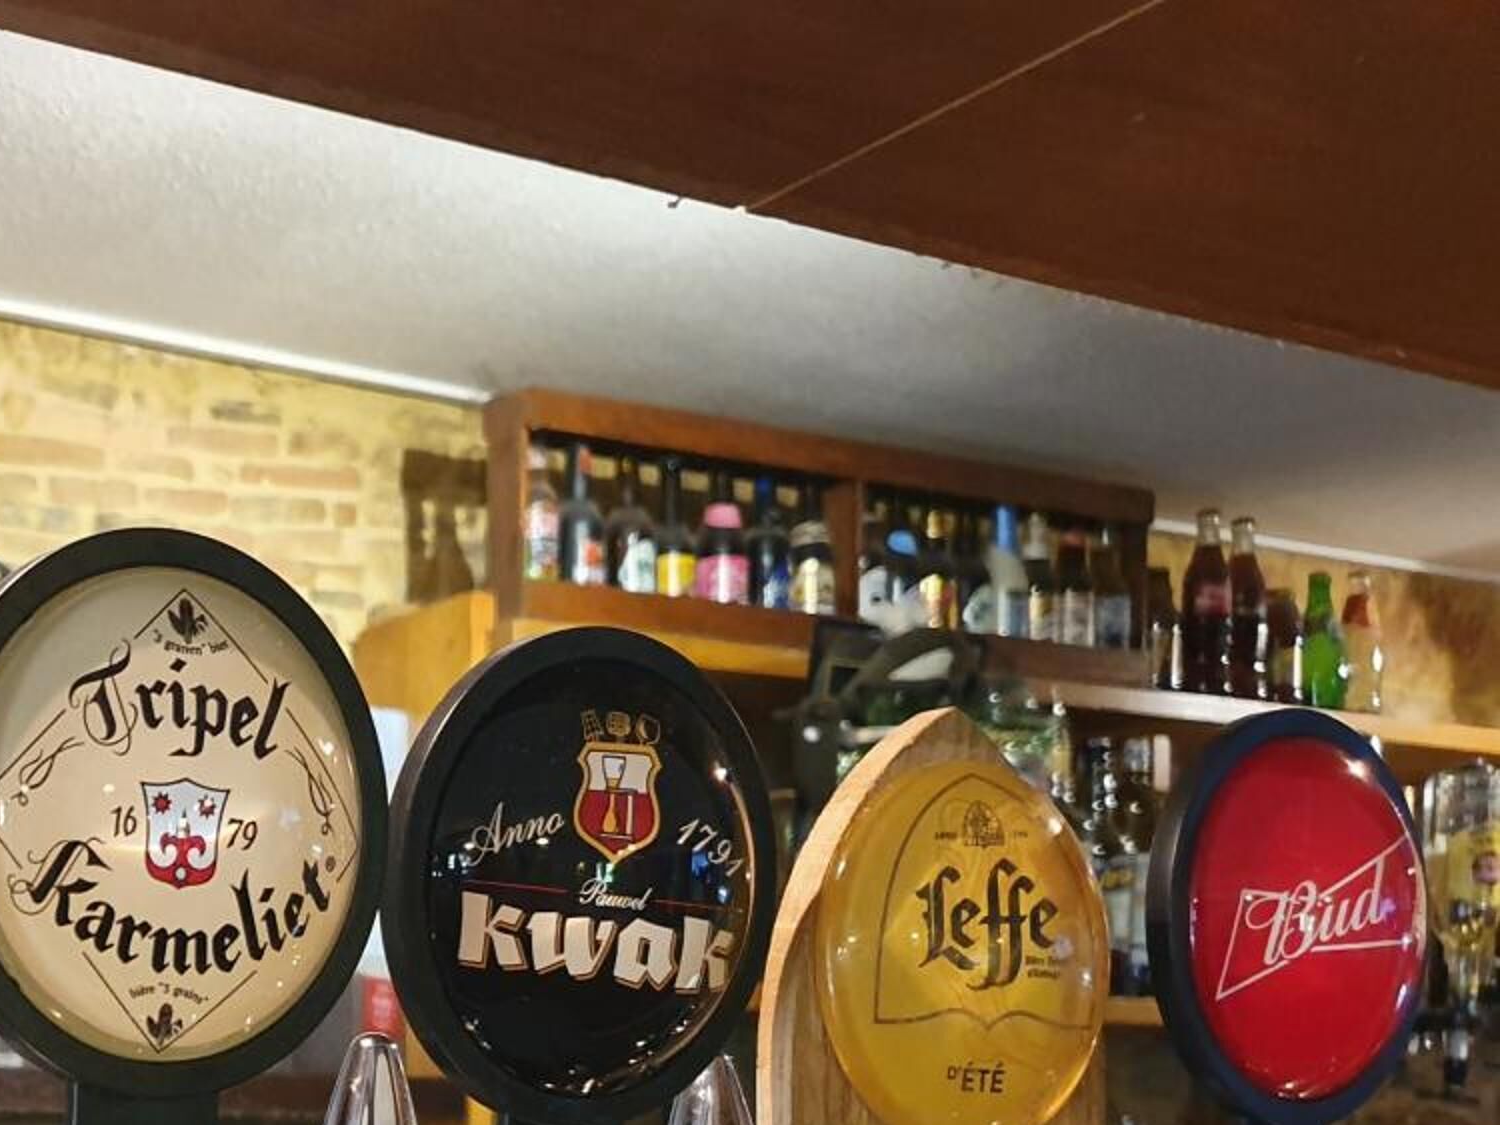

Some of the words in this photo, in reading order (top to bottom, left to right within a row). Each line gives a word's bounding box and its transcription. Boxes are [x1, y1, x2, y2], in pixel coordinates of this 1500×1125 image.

[68, 636, 291, 760] Tripel
[110, 806, 138, 838] 16
[227, 816, 259, 851] 79
[464, 801, 565, 867] Anno
[8, 838, 331, 976] Karmeliet
[578, 876, 653, 911] Pauwel
[915, 857, 1060, 992] Leffe
[1244, 856, 1386, 967] Bud
